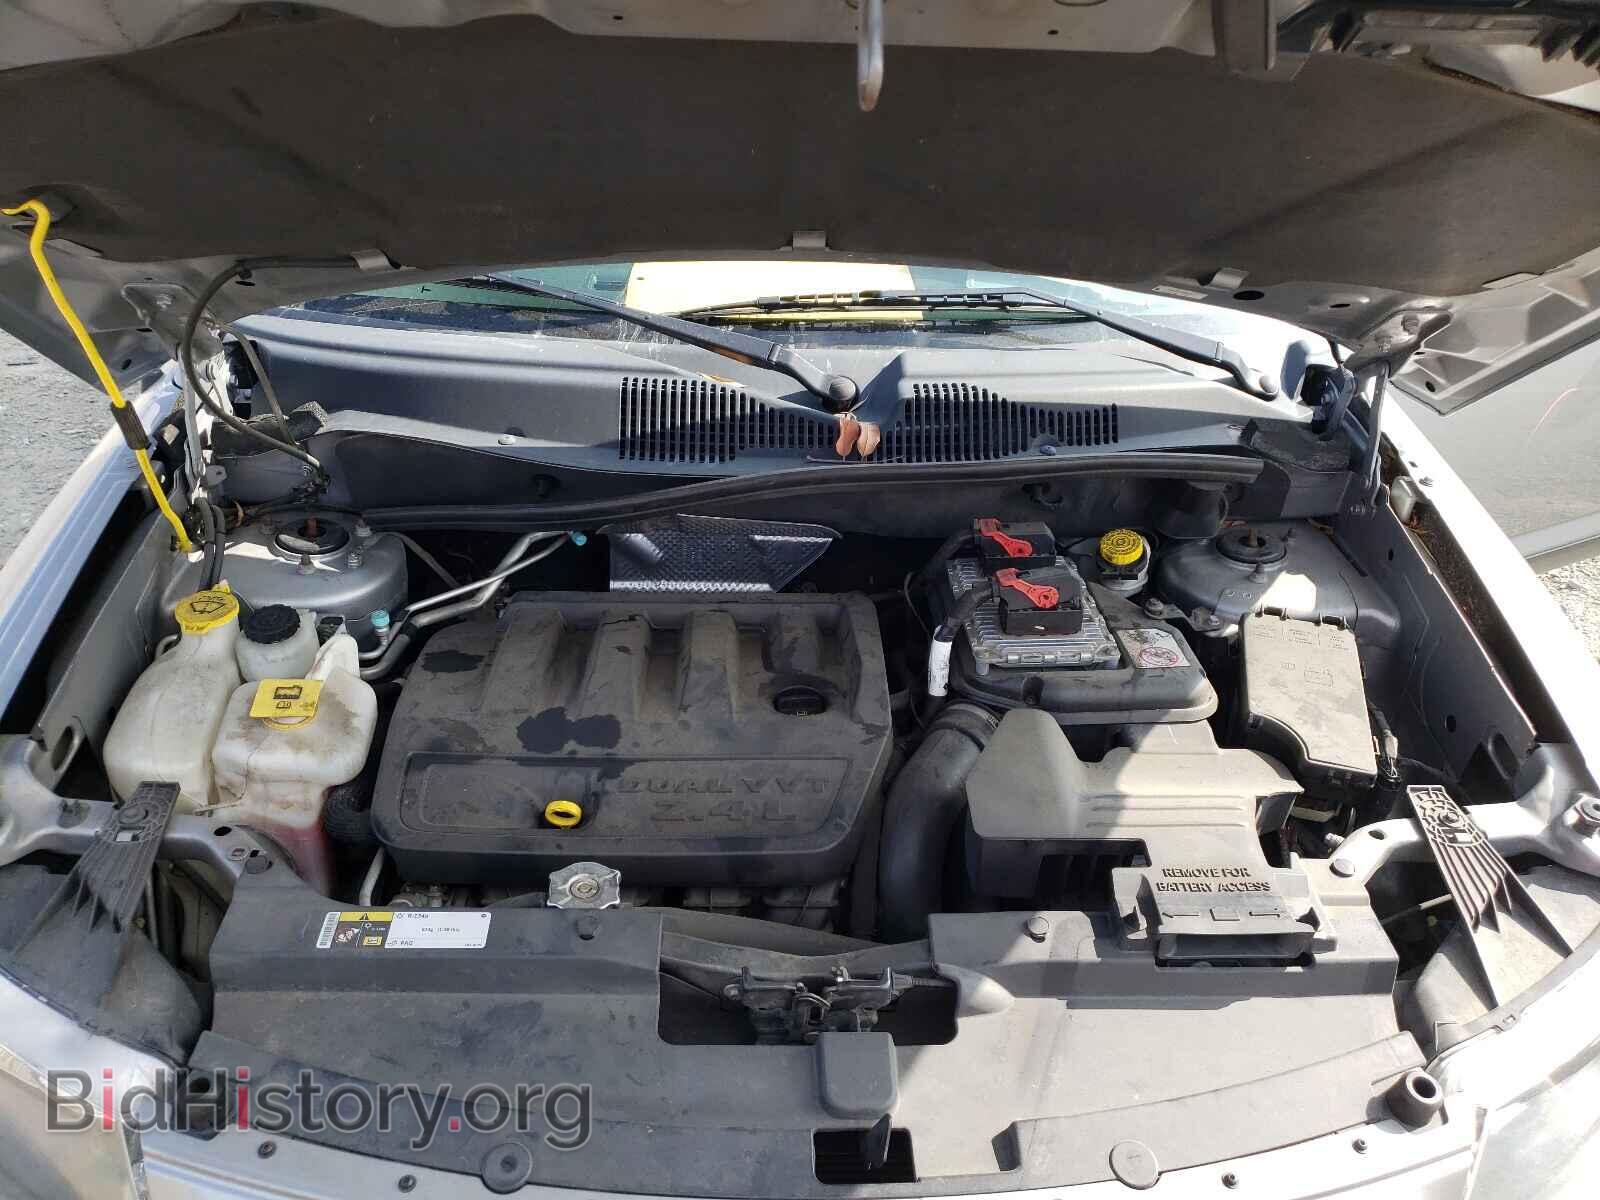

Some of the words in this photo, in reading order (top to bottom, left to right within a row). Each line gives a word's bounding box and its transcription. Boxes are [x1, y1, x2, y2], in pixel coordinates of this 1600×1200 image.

[616, 776, 735, 794] DUAL
[1161, 867, 1220, 878] REMOVE
[1222, 867, 1251, 878] FOR
[1156, 881, 1214, 893] BATTERY
[1217, 881, 1271, 893] ACCESS
